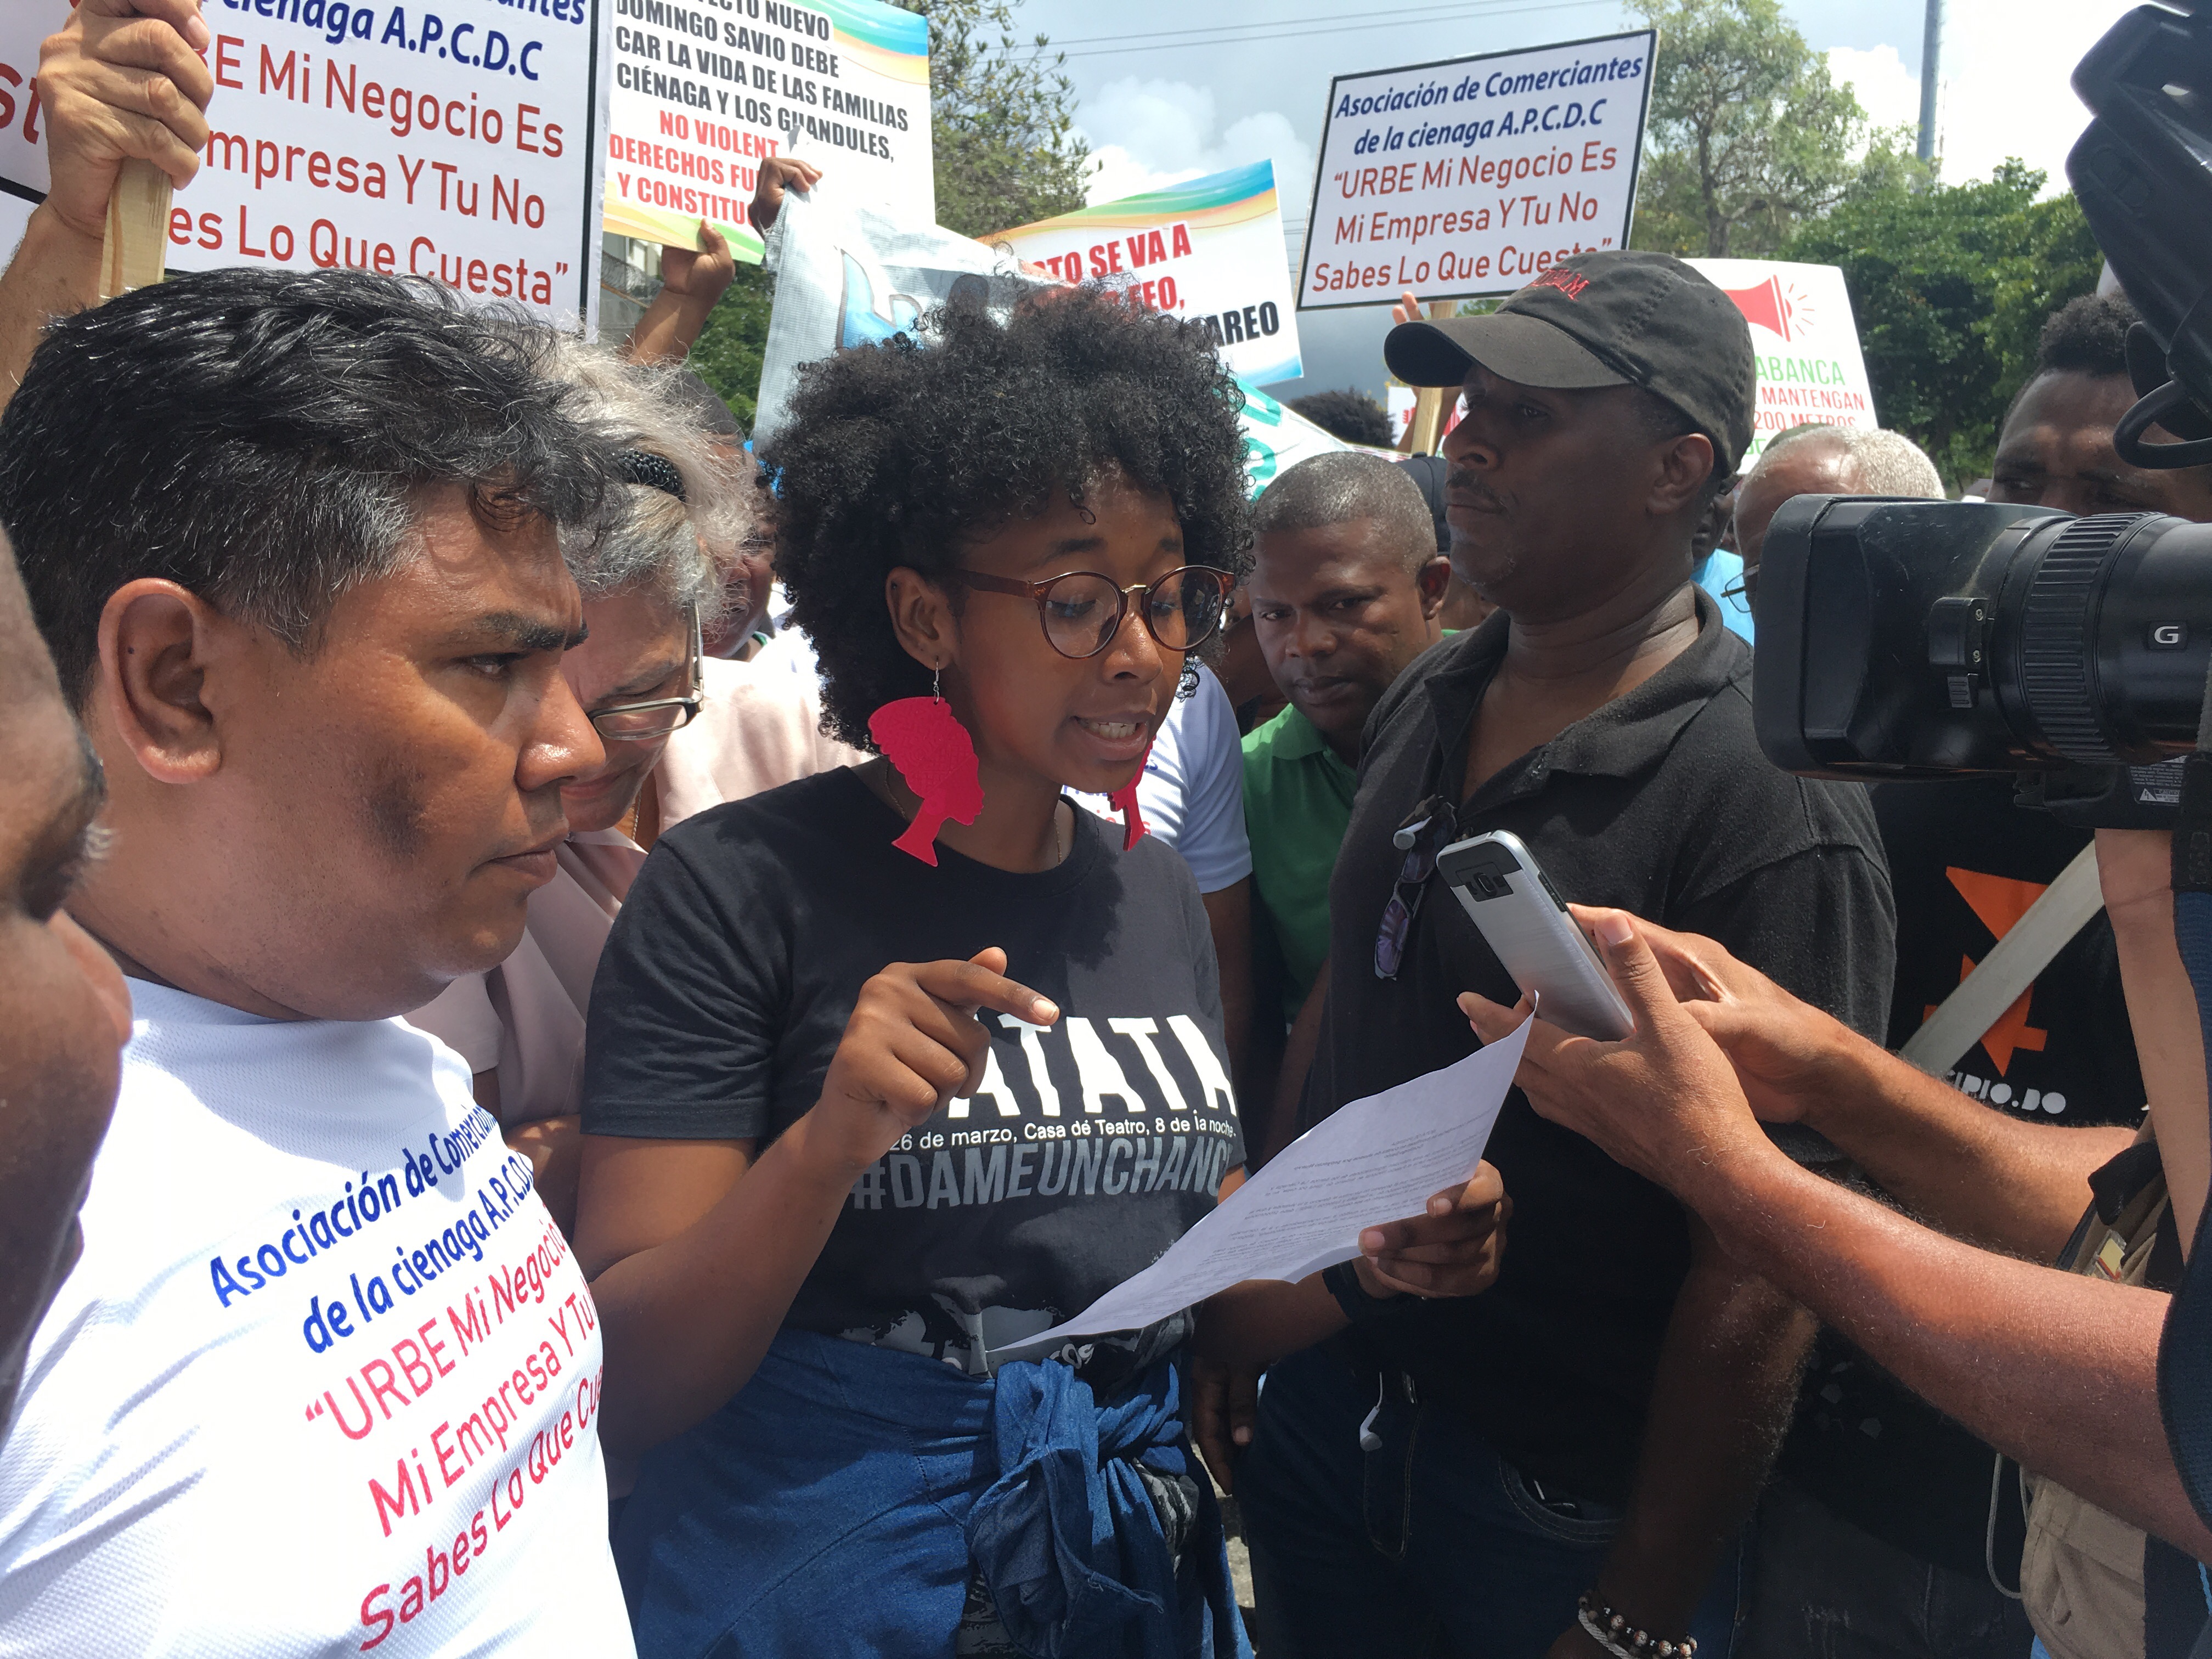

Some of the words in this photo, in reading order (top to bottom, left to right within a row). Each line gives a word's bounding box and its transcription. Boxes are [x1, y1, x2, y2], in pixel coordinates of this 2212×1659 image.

[381, 7, 543, 81] A.P.C.D.C
[617, 0, 717, 42] DOMINGO
[725, 23, 785, 61] SAVIO
[792, 42, 839, 78] DEBE
[766, 2, 830, 41] NUEVO
[259, 43, 311, 104] Mi
[326, 58, 503, 144] Negocio
[516, 103, 564, 158] Es
[616, 26, 660, 61] CAR
[668, 40, 691, 69] LA
[696, 47, 747, 86] VIDA
[753, 65, 777, 94] DE
[783, 74, 817, 105] LAS
[823, 85, 909, 132] FAMILIAS
[617, 62, 712, 111] CIÉNAGA
[716, 91, 731, 115] Y
[735, 95, 772, 127] LOS
[1335, 81, 1447, 119] Asociación
[1453, 75, 1480, 103] de
[1485, 56, 1643, 97] Comerciantes
[659, 110, 689, 140] NO
[1353, 129, 1380, 154] de
[1384, 126, 1403, 151] la
[1408, 118, 1492, 149] cienaga
[1497, 99, 1607, 137] A.P.C.D.C
[397, 153, 424, 205] Y
[432, 161, 478, 217] Tu
[492, 173, 545, 228] No
[610, 133, 724, 184] DERECHOS
[731, 163, 759, 192] FU
[1333, 163, 1417, 199] “URBE
[1421, 159, 1452, 190] Mi
[1458, 145, 1573, 190] Negocio
[1581, 140, 1617, 172] Es
[617, 172, 630, 197] Y
[637, 177, 753, 227] CONSTITU
[1335, 213, 1364, 245] Mi
[1369, 207, 1490, 245] Empresa
[1499, 198, 1516, 229] Y
[1520, 195, 1550, 226] Tu
[1559, 191, 1598, 223] No
[240, 205, 294, 262] Lo
[310, 218, 396, 277] Que
[1032, 251, 1082, 285] TO
[1089, 240, 1123, 278] SE
[1126, 229, 1167, 269] VA
[1172, 224, 1192, 258] A
[1312, 263, 1391, 292] Sabes
[1398, 256, 1429, 285] Lo
[1437, 251, 1489, 281] Que
[1762, 386, 1865, 411] MANTENGAN
[2154, 625, 2180, 644] G
[920, 1131, 944, 1149] de
[952, 1128, 1017, 1146] marzo,
[1024, 1122, 1066, 1140] Casa
[1094, 1119, 1150, 1136] Teatro,
[1155, 1117, 1166, 1133] 8
[1170, 1117, 1190, 1132] de
[209, 1172, 402, 1308] Asociación
[402, 1147, 438, 1198] de
[303, 1295, 354, 1353] de
[351, 1272, 392, 1323] la
[391, 1209, 491, 1296] cienaga
[305, 1317, 457, 1440] “URBE
[446, 1286, 491, 1356] Mi
[488, 1219, 566, 1324] Negocio
[367, 1447, 433, 1537] Mi
[430, 1341, 562, 1488] Empresa
[548, 1307, 573, 1357] Y
[565, 1292, 595, 1340] Tu
[359, 1511, 488, 1652] Sabes
[491, 1467, 523, 1532] Lo
[529, 1410, 573, 1485] Que
